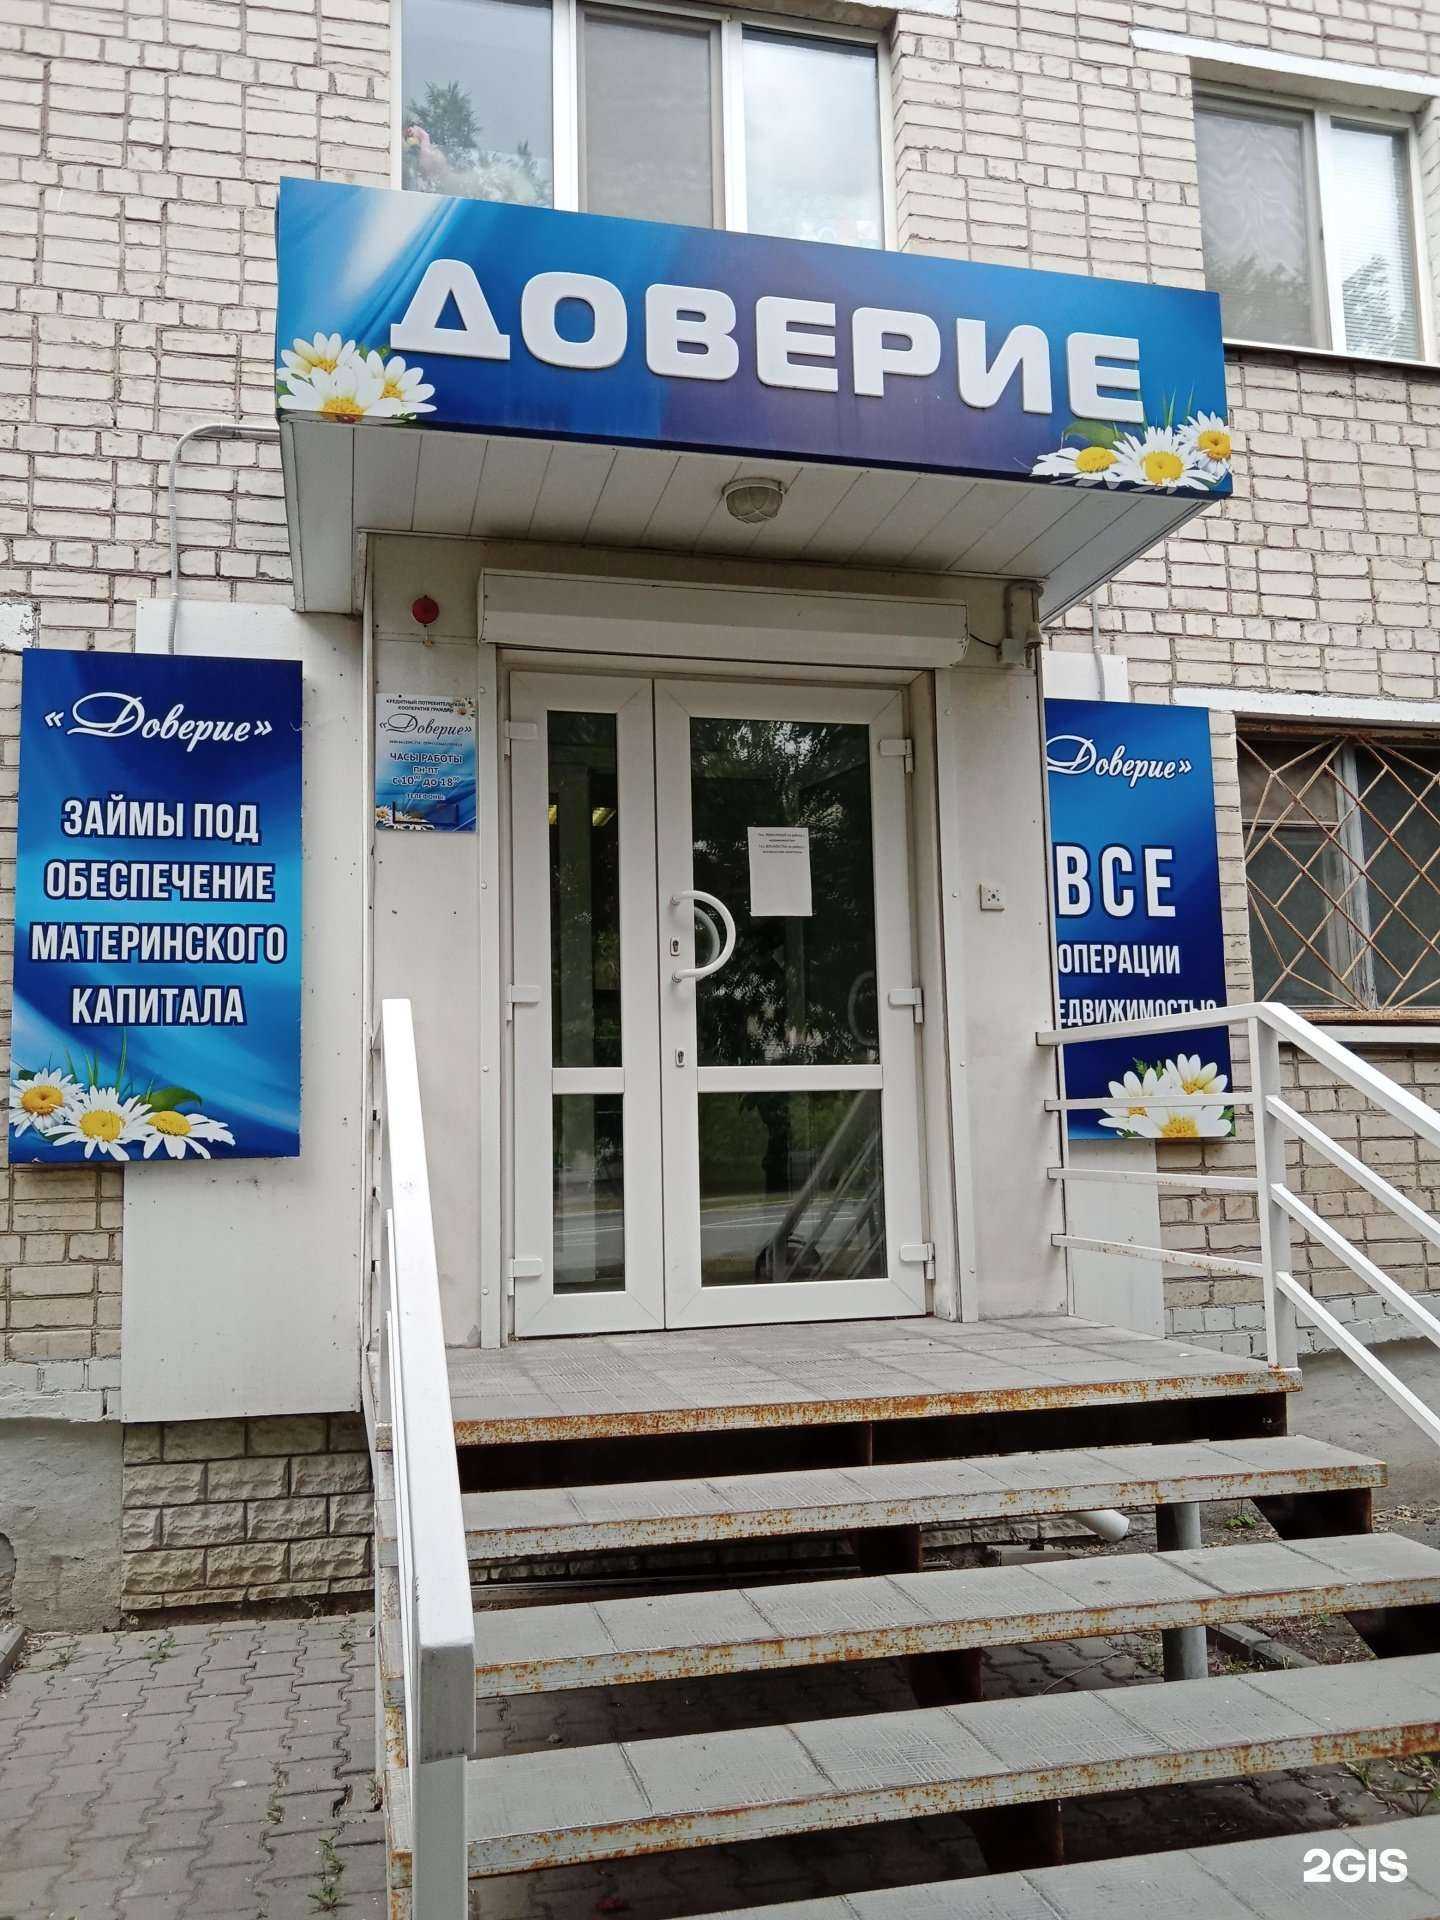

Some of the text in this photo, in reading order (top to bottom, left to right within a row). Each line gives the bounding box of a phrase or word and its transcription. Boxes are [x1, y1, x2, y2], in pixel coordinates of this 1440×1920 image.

[390, 258, 1145, 423] ДОВЕРИЕ
[43, 691, 273, 753] «Доверие»
[379, 713, 473, 740] «Доверие»
[390, 752, 463, 763] ЧАСЫ РАБОТЫ
[63, 794, 260, 843] ЗАЙМЫ ПОД
[45, 861, 274, 901] ОБЕСПЕЧЕНИЕ
[1055, 845, 1176, 918] ВСЕ
[31, 925, 286, 962] МАТЕРИНСКОГО
[1058, 943, 1181, 978] ОПЕРАЦИИ
[72, 988, 245, 1024] КАПИТАЛА
